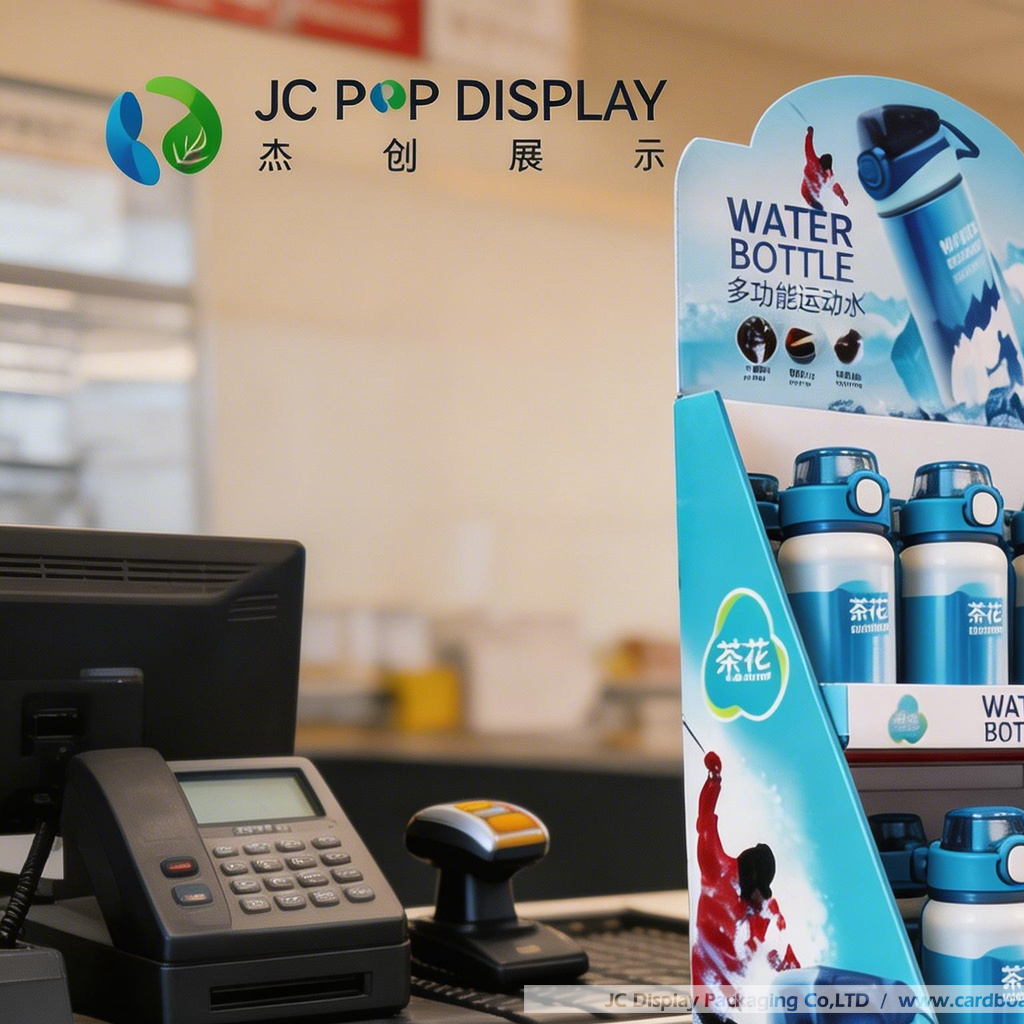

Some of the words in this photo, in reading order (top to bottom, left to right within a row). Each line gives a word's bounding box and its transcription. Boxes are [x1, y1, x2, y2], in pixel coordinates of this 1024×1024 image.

[727, 197, 853, 248] WATER
[731, 238, 854, 283] BOTTLE
[728, 276, 865, 317] 多功能运动水
[715, 638, 771, 676] 茶花
